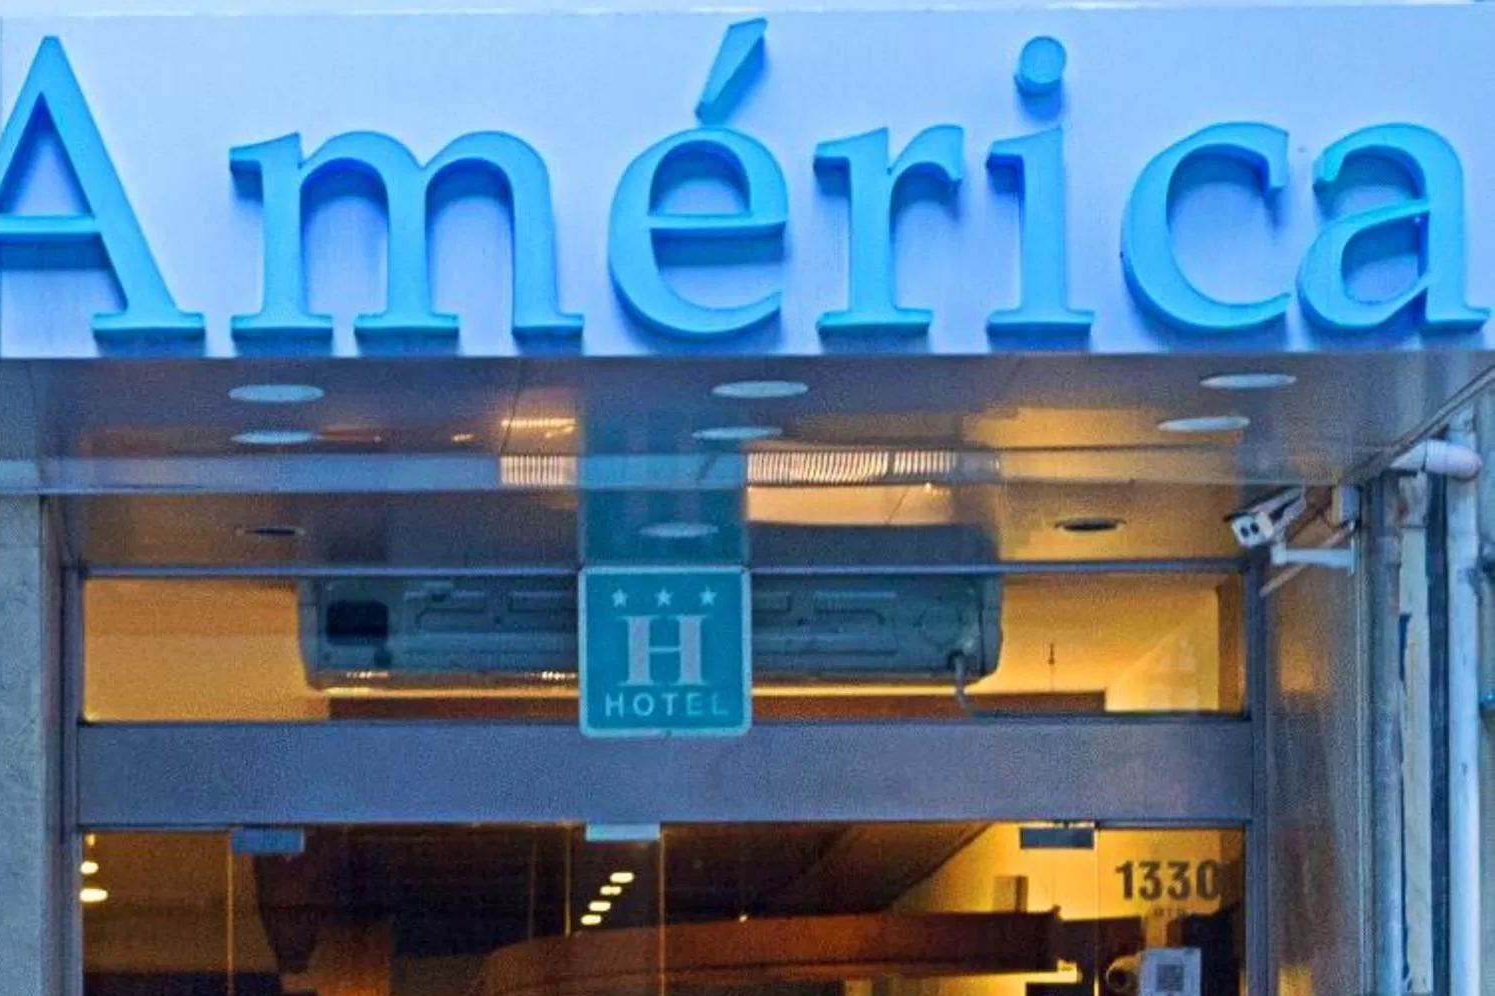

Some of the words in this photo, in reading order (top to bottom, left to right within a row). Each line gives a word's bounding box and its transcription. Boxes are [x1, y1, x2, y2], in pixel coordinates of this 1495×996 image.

[617, 613, 711, 687] H
[605, 691, 729, 718] HOTEL
[1115, 860, 1220, 901] 1330
